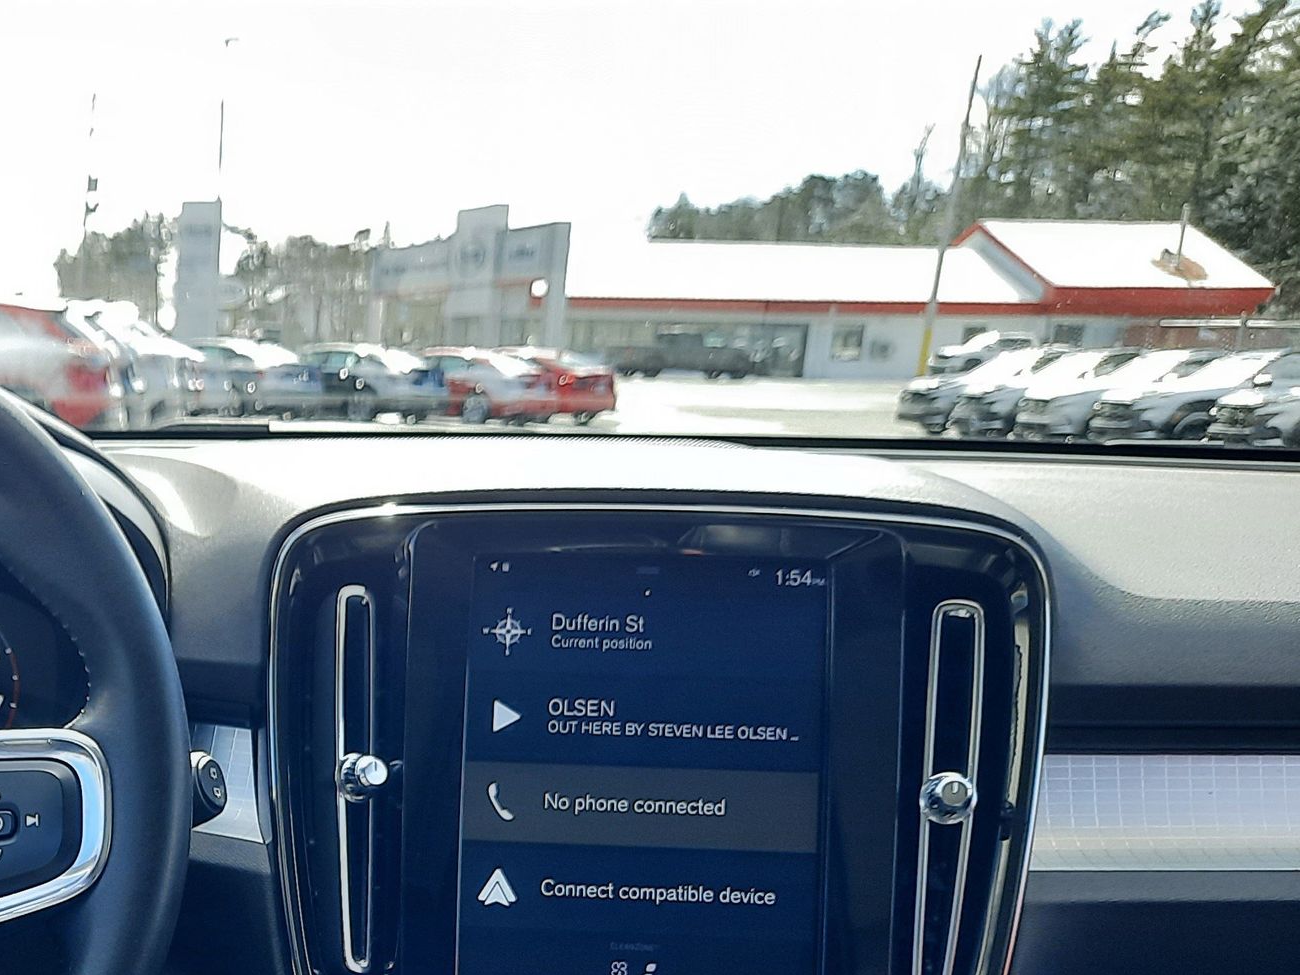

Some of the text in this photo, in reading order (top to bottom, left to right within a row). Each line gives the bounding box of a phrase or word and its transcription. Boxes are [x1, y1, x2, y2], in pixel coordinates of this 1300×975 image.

[552, 613, 645, 633] Dufferin St
[551, 634, 652, 652] Current position
[549, 698, 616, 717] OLSEN
[548, 720, 788, 741] OUT HERE BY STEVEN LEE OLSEN
[544, 792, 726, 816] No phone connected
[540, 878, 777, 905] Connect compatible device
